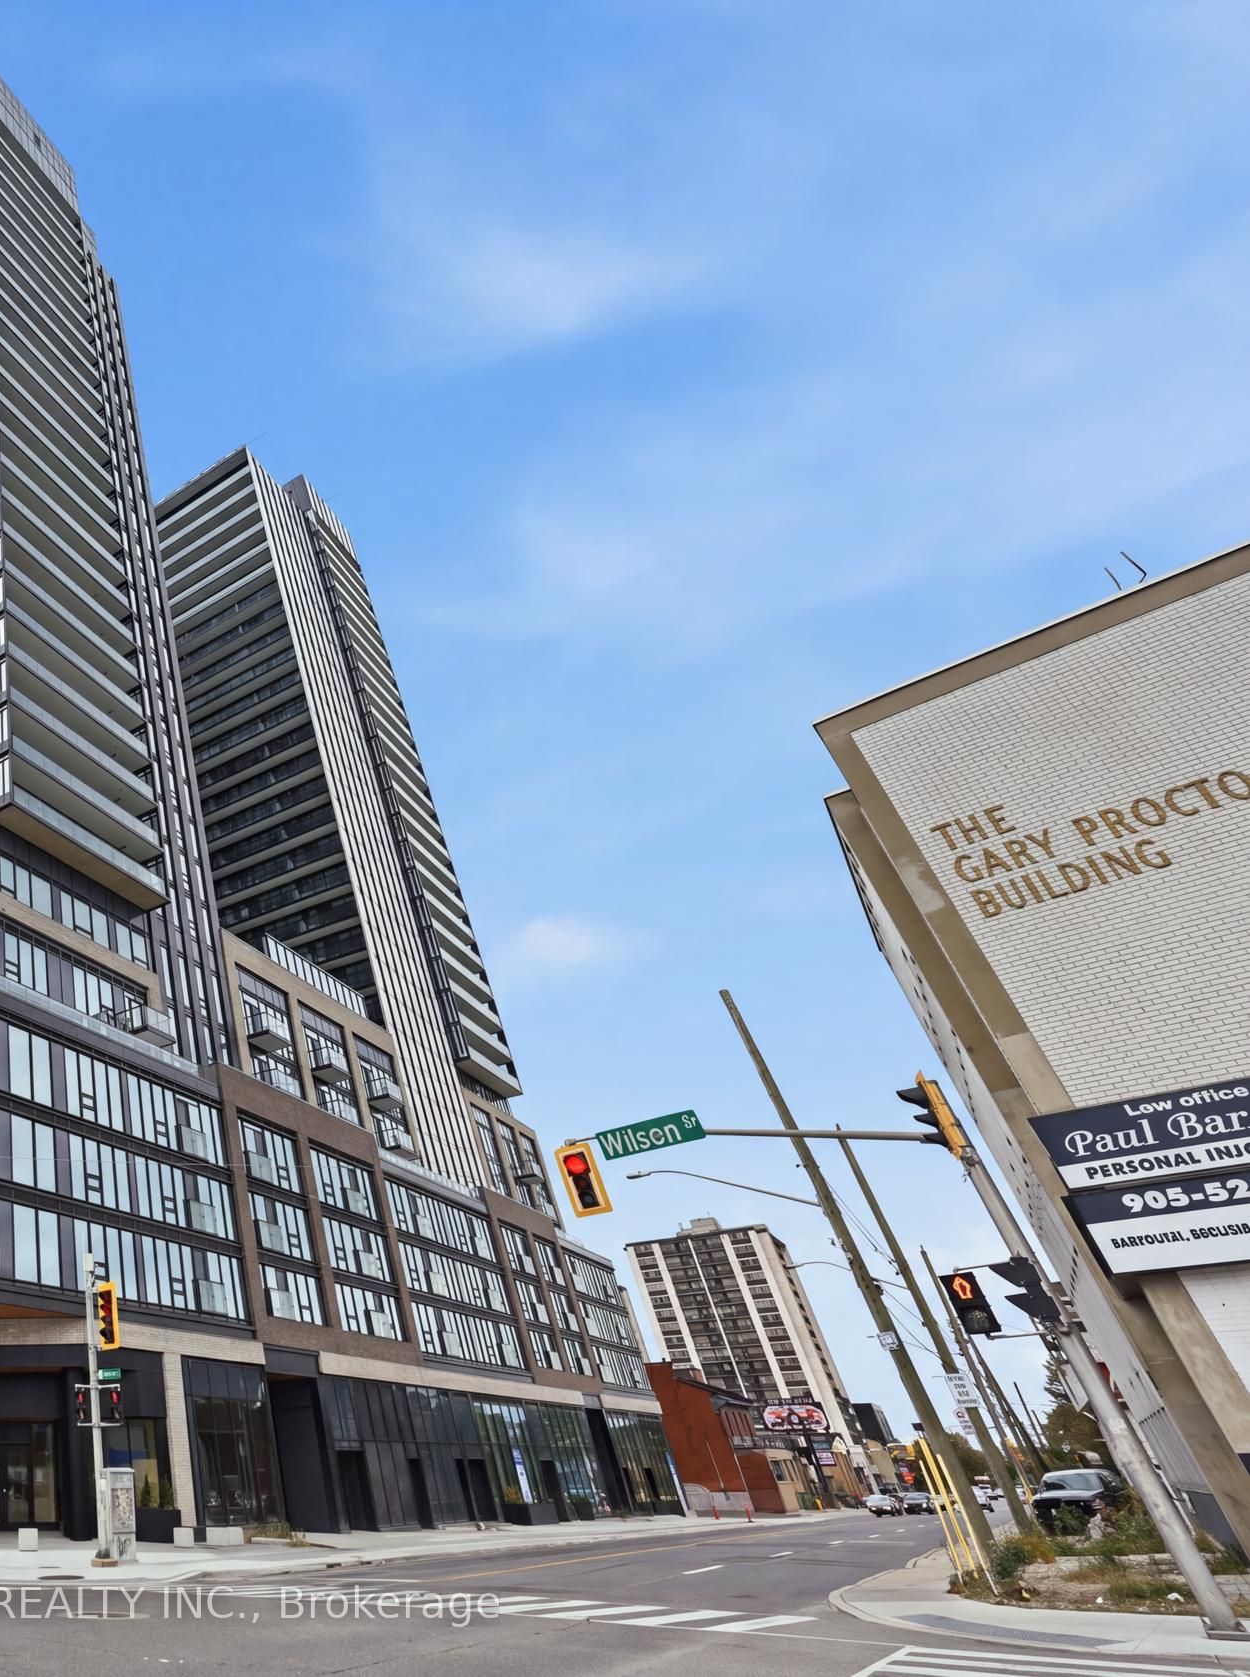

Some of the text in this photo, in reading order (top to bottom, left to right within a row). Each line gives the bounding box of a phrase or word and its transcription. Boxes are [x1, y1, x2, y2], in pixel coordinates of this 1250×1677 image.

[930, 804, 1017, 850] THE
[954, 770, 1250, 882] GARY PROCTO
[969, 839, 1172, 918] BUILDING
[1179, 1086, 1250, 1106] office
[599, 1124, 682, 1156] Wilson
[1065, 1110, 1250, 1157] Paul Bar
[1085, 1151, 1203, 1180] PERSONAL
[1121, 1178, 1250, 1213] 905-52
